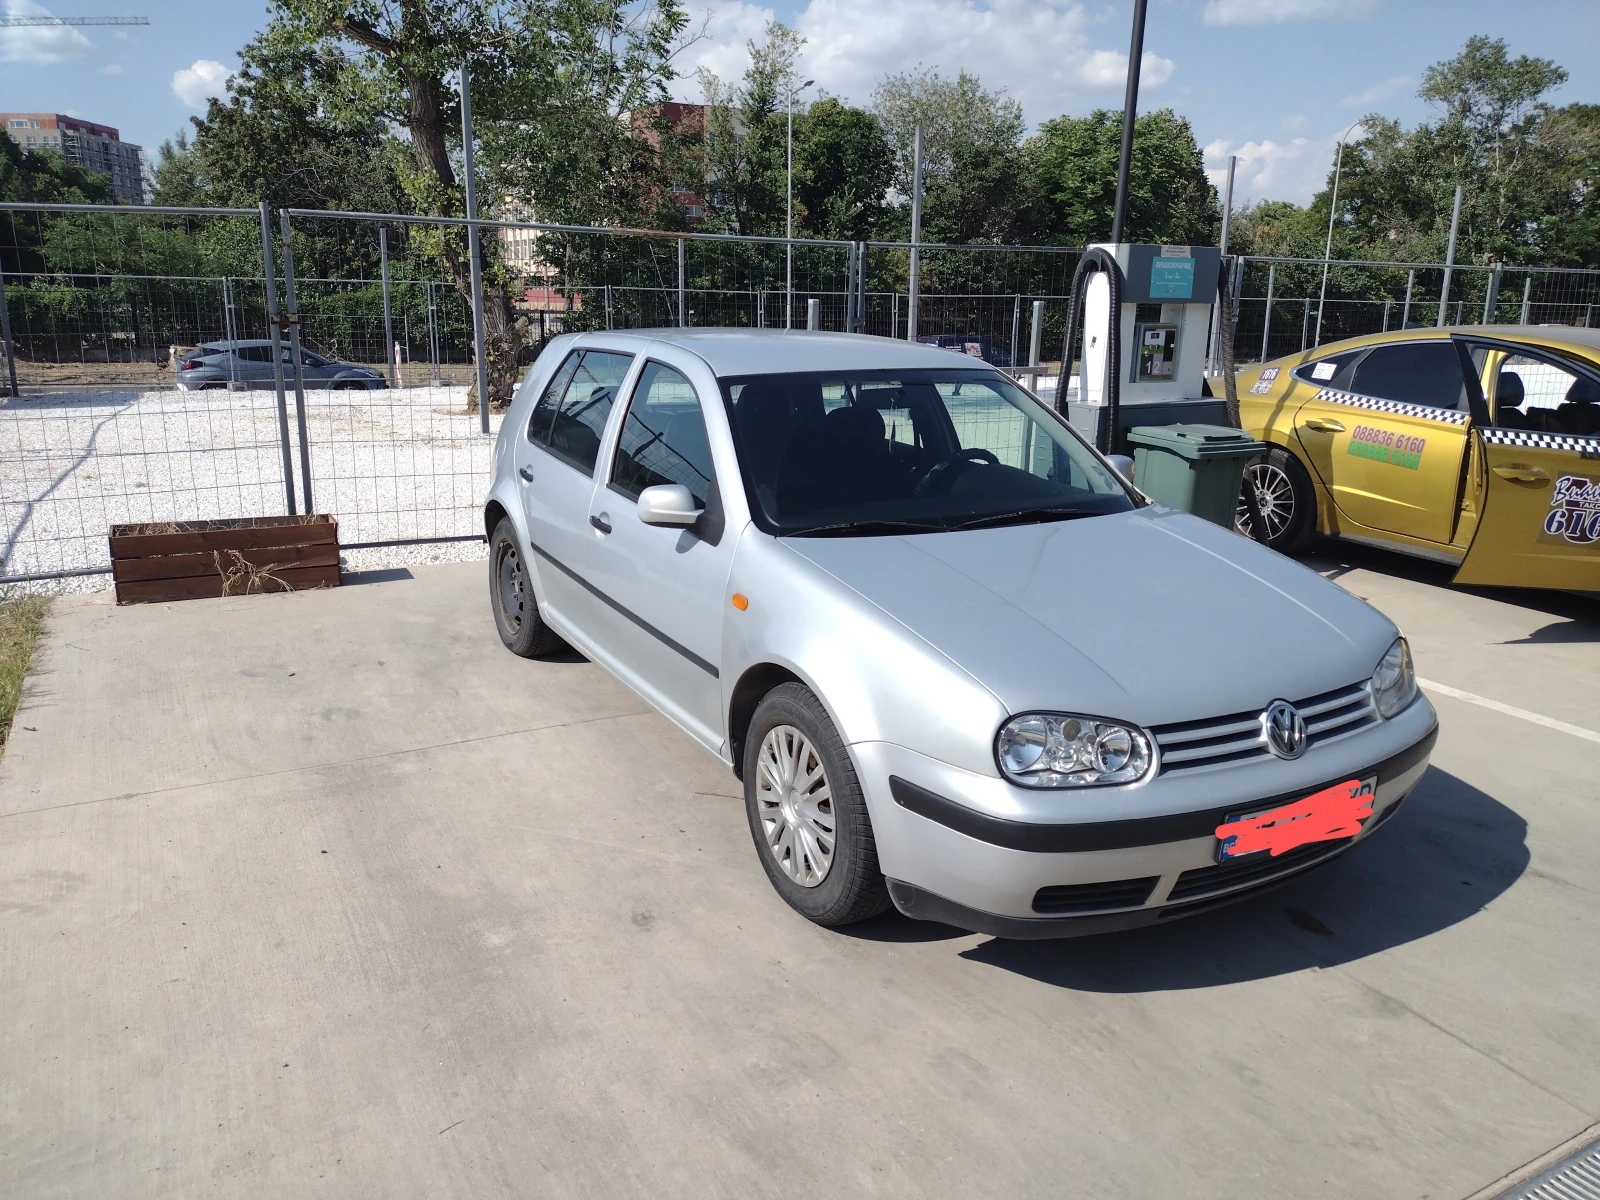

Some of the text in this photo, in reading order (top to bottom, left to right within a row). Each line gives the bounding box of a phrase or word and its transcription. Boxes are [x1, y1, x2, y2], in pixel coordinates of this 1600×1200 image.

[1352, 425, 1426, 454] 088836 6160
[1391, 449, 1421, 471] 6160
